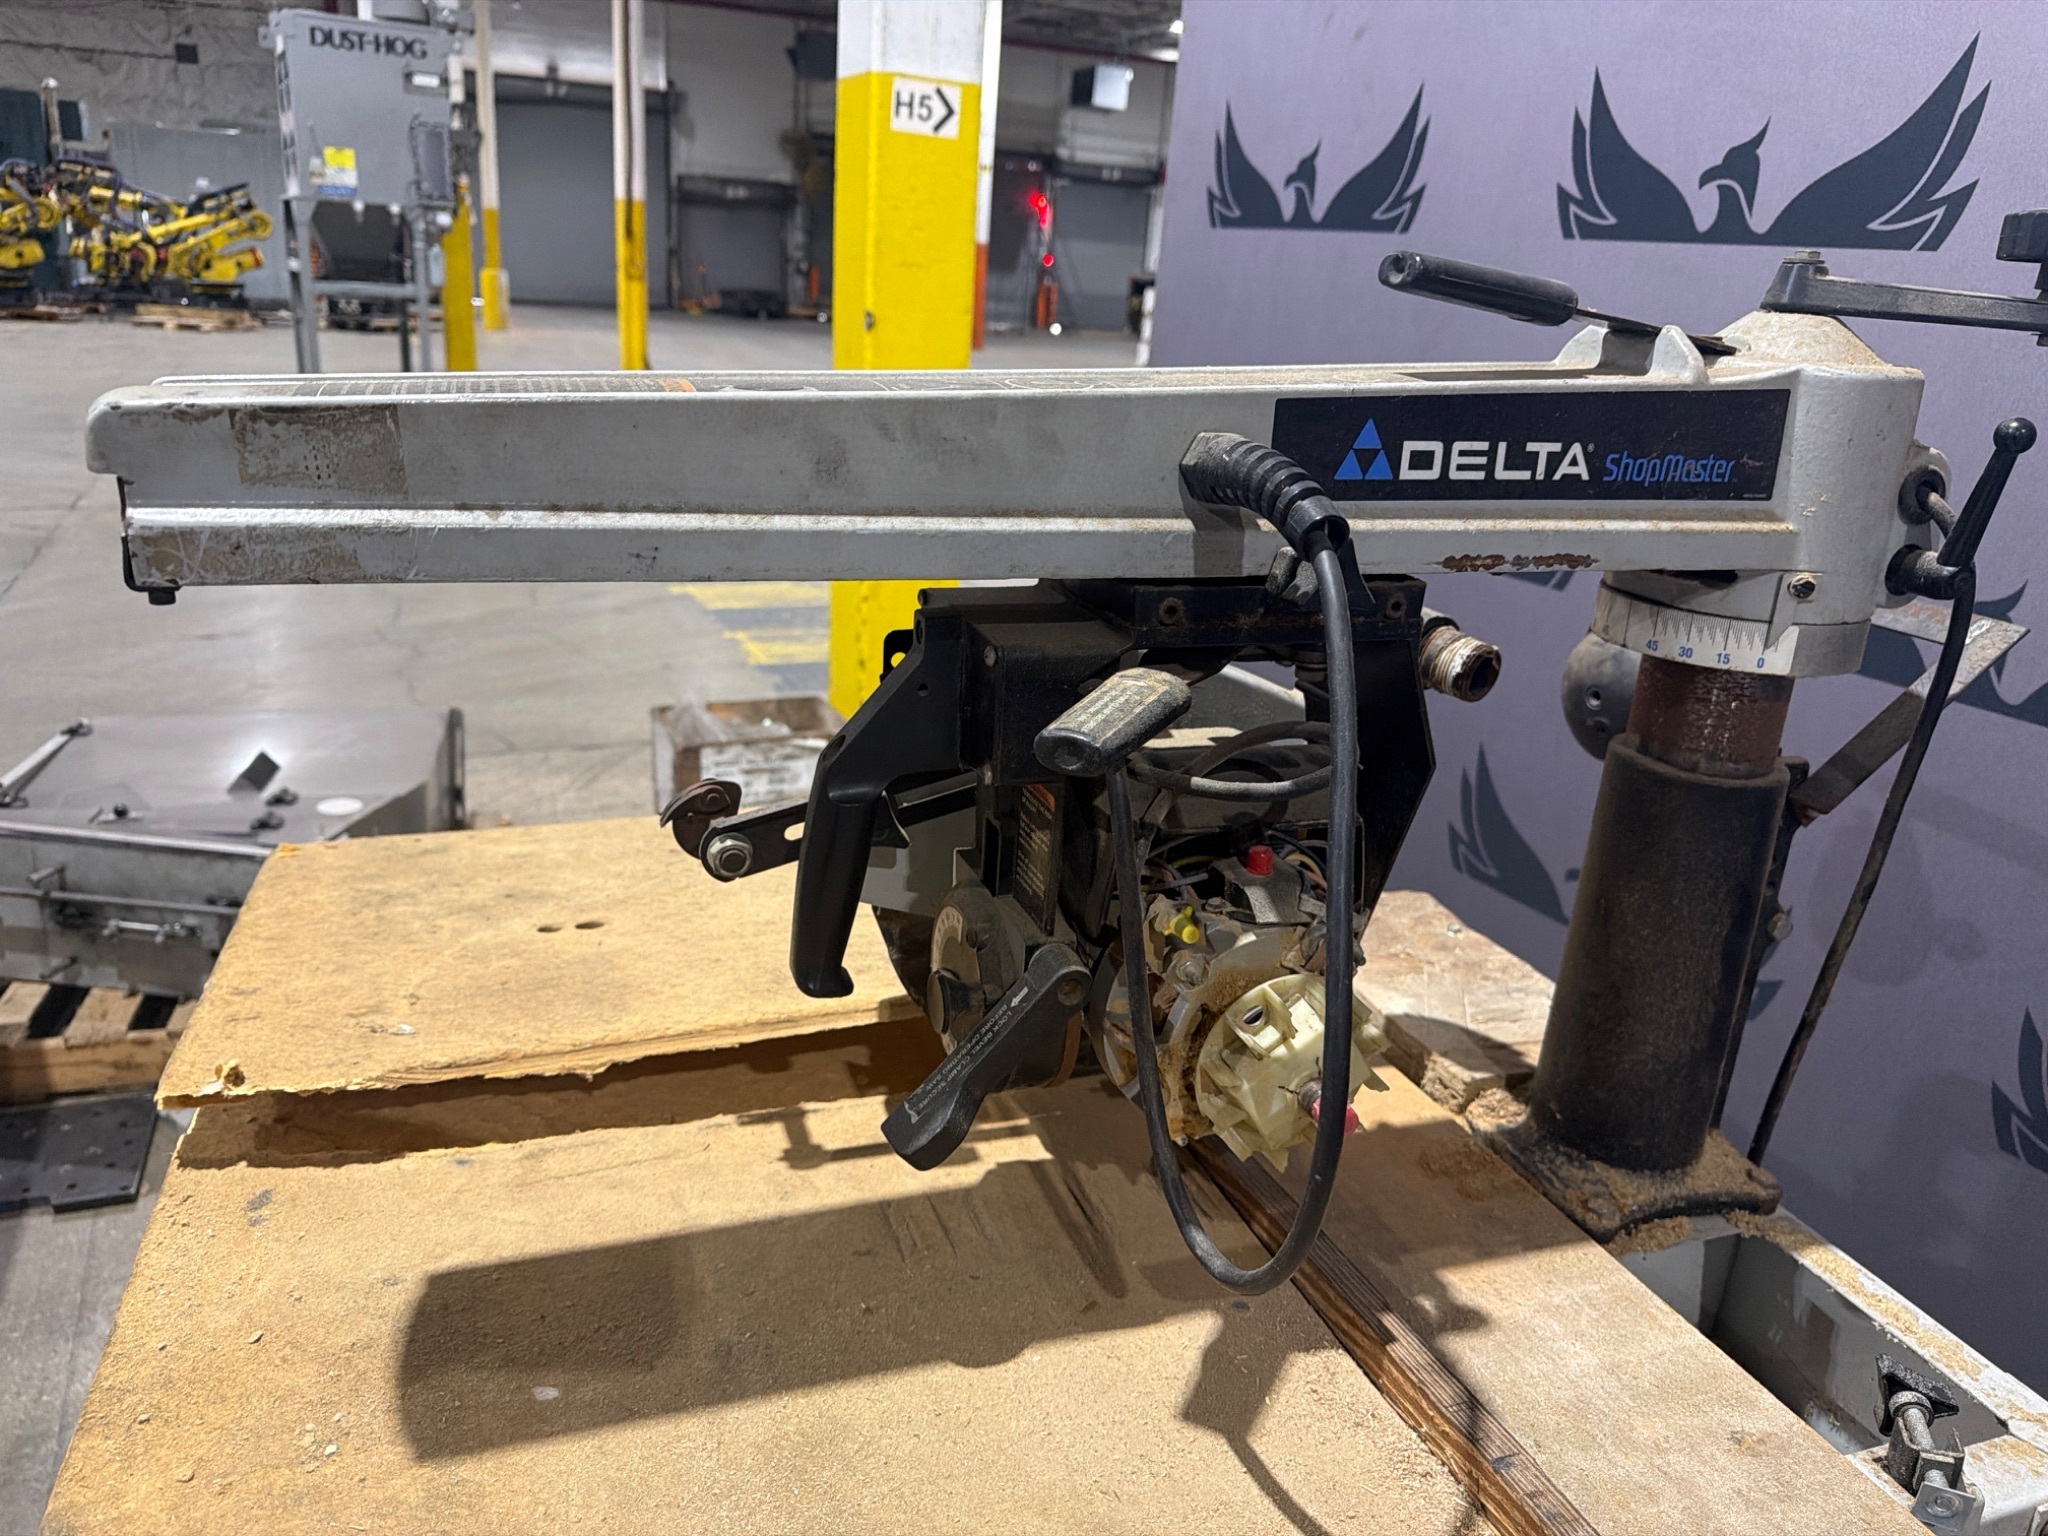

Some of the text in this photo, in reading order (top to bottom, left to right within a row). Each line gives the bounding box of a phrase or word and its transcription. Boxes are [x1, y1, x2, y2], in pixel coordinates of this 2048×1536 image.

[310, 26, 427, 60] DUST-HOG
[895, 90, 932, 122] H5
[1399, 441, 1736, 487] DELTA ShopMaster
[1646, 639, 1765, 669] 45 30 15 0
[992, 1010, 1012, 1033] LOCK
[925, 1004, 1008, 1091] BEFORE OPERATING SAW
[970, 1032, 993, 1055] BEVEL
[947, 1055, 971, 1082] CLAMP
